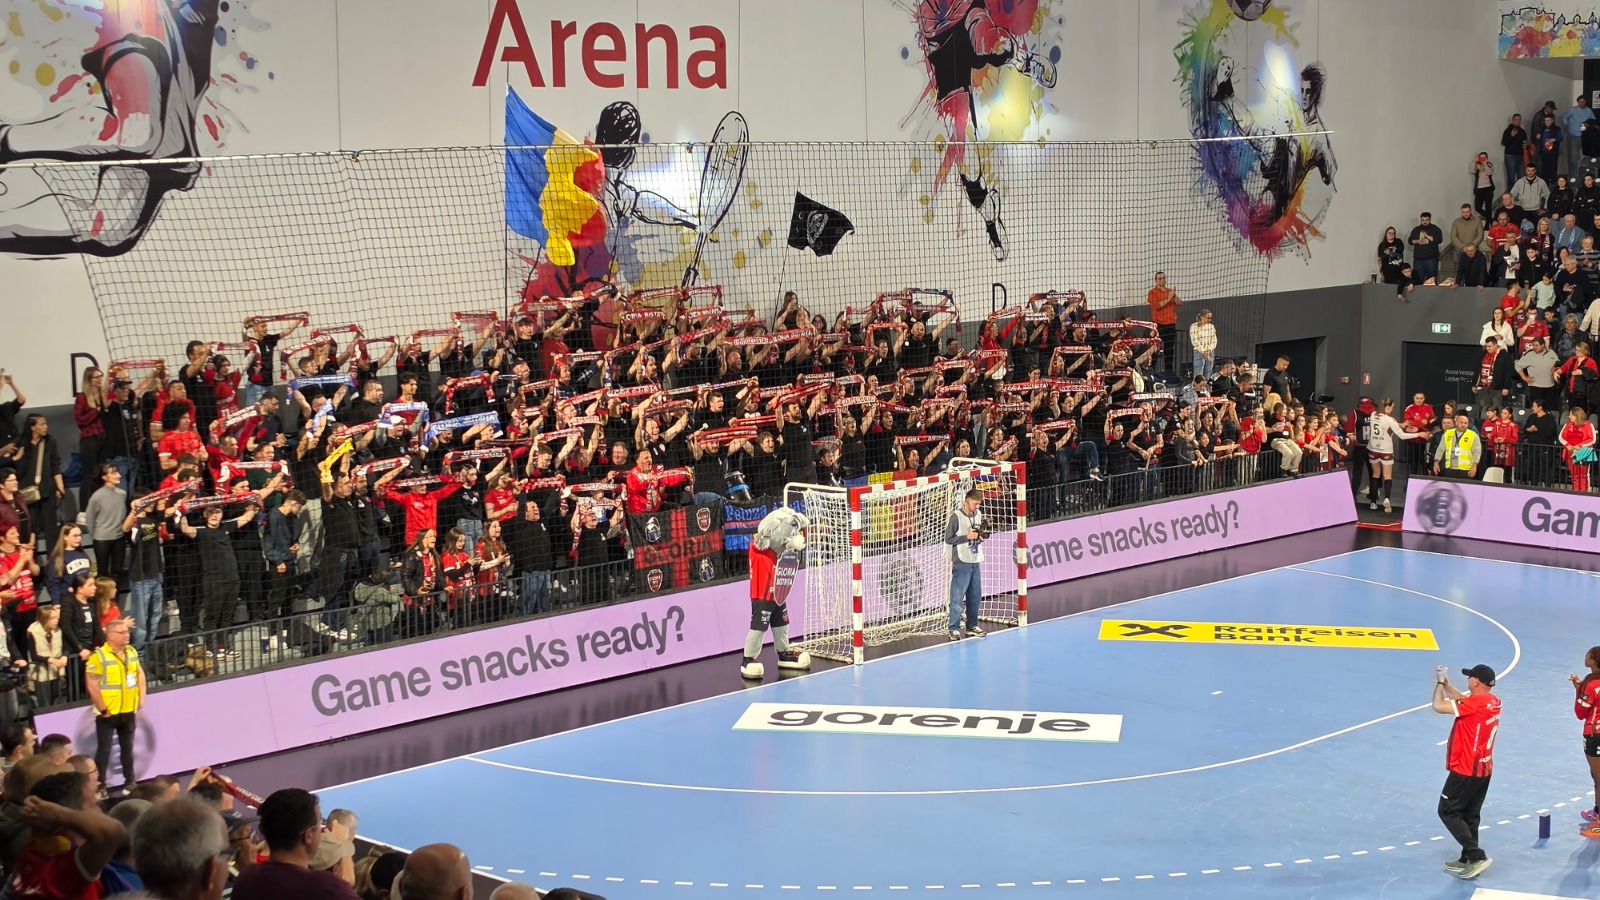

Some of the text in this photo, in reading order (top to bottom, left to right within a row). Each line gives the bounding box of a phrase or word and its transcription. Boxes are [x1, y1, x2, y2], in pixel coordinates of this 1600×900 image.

[472, 0, 727, 89] Arena
[1373, 423, 1380, 436] 5
[1087, 516, 1167, 557] snacks
[1170, 500, 1239, 541] ready?
[1522, 496, 1600, 539] Gam
[643, 539, 713, 564] GLORIA
[776, 567, 796, 577] GLORIA
[1214, 625, 1417, 639] Raiffeisen
[1214, 633, 1315, 643] Bank
[311, 605, 685, 717] Game snacks ready?
[767, 709, 1090, 734] gorenje
